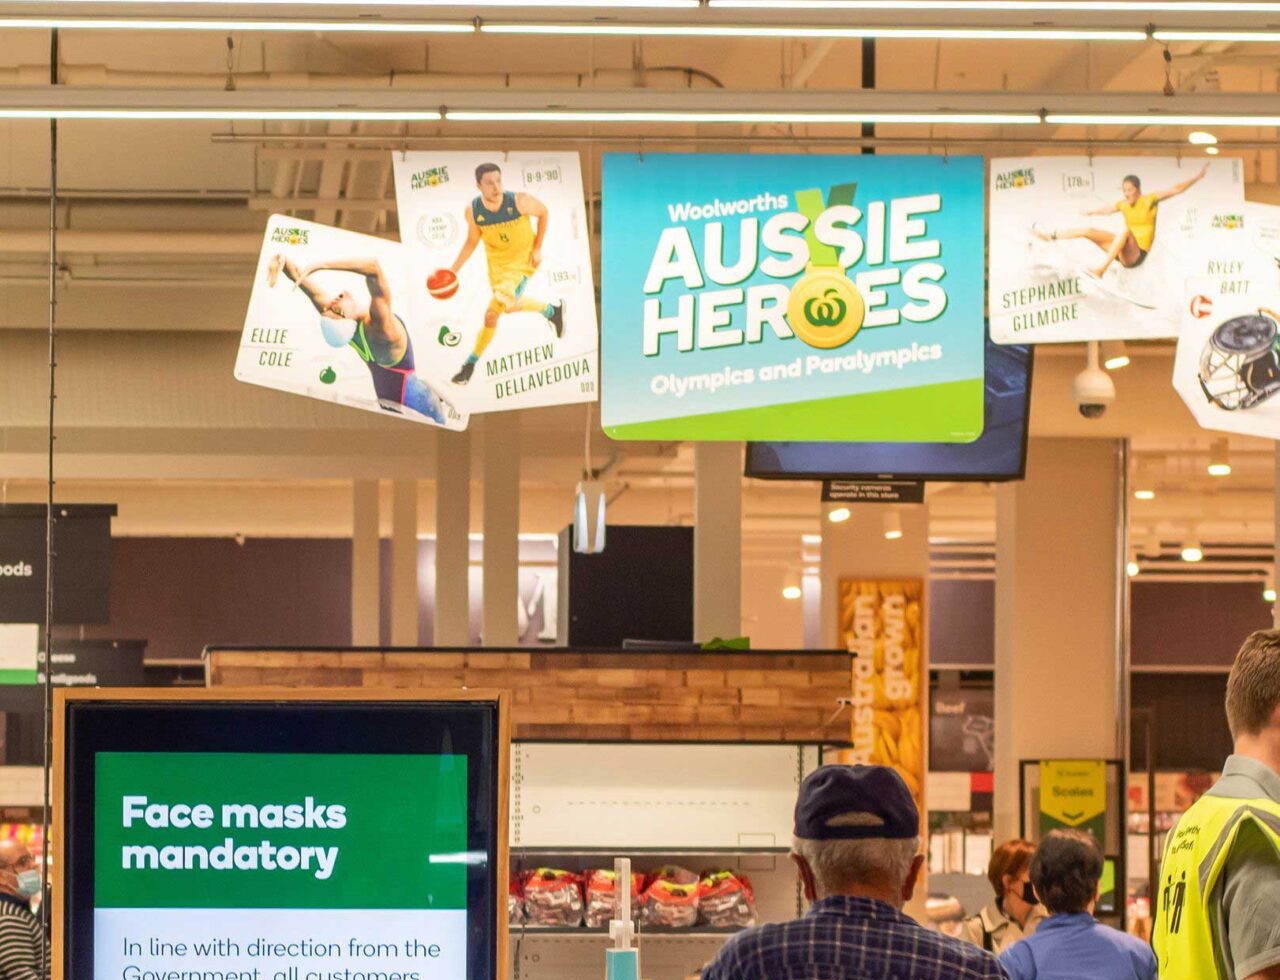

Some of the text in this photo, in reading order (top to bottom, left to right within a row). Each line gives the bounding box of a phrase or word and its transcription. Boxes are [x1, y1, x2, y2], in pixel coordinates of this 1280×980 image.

[667, 192, 788, 222] Woolworths
[642, 193, 942, 295] AUSSIE
[1207, 260, 1244, 274] RYLEY
[1002, 277, 1082, 309] STEPHANIE
[1220, 280, 1251, 295] BATT
[1013, 303, 1079, 332] GILMORE
[250, 328, 288, 345] ELLIE
[258, 351, 294, 368] COLE
[486, 343, 554, 377] MATTHEW
[650, 342, 942, 398] Olympics and Paralympics
[495, 358, 590, 400] DELLAVEDOVA
[37, 652, 76, 664] Ceese
[37, 673, 97, 686] Sallgoods
[1051, 783, 1094, 797] Scales
[122, 795, 347, 829] Face masks
[122, 838, 339, 880] mandatory
[123, 937, 441, 958] In line with direction from the
